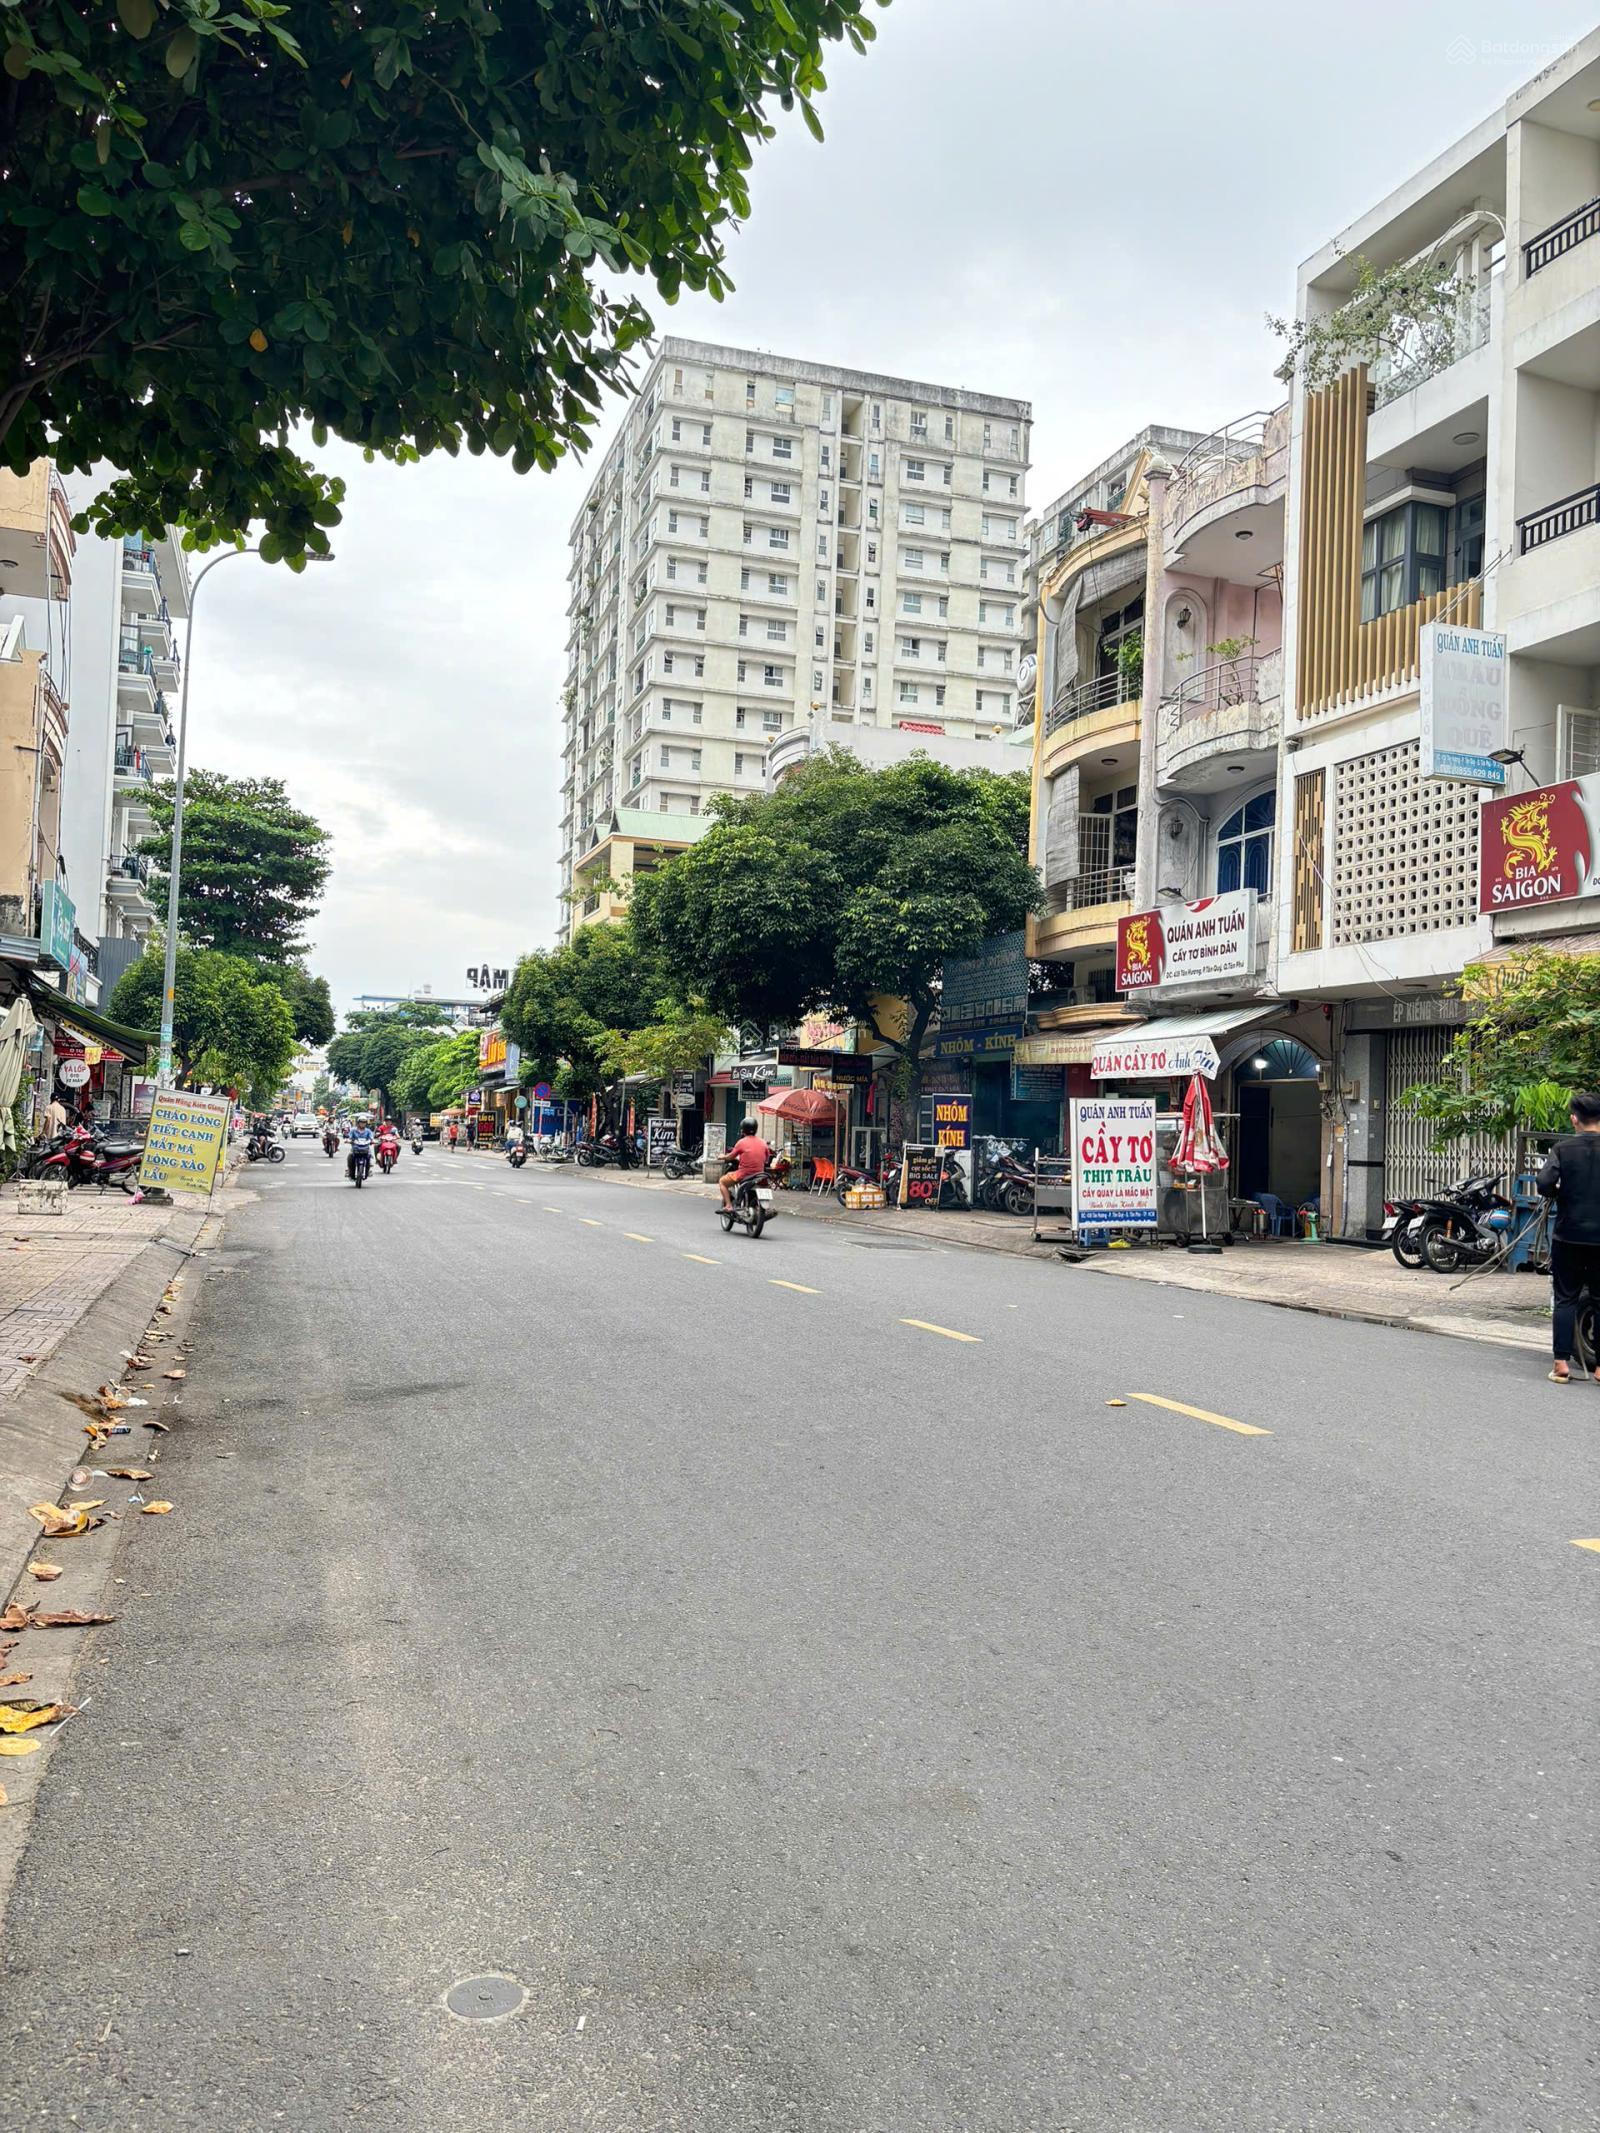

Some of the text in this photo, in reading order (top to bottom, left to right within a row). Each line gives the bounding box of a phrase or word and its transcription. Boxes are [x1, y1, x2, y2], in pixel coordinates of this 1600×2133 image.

[1437, 632, 1503, 658] QUÁN ANH TUẤN
[1515, 865, 1537, 880] BIA
[1492, 873, 1561, 904] SAIGON
[1167, 908, 1245, 943] QUÁN ANH TUẤN
[1201, 944, 1219, 958] BÌNH
[1220, 940, 1237, 955] DÂN
[1121, 969, 1152, 986] SAIGON
[941, 1037, 974, 1054] NHÔM
[1092, 1050, 1121, 1076] QUÁN
[1151, 1049, 1166, 1070] TƠ
[156, 1109, 187, 1121] CHÁO
[936, 1100, 968, 1121] NHÔM
[1080, 1101, 1152, 1122] QUÁN ANH TUẤN
[152, 1123, 214, 1142] TIẾT CANH
[652, 1128, 675, 1140] Kim
[938, 1125, 966, 1147] KÍNH
[1082, 1121, 1153, 1163] CẦY TƠ
[146, 1153, 177, 1167] LÒNG
[1083, 1165, 1152, 1186] THỊT TRÂU
[1097, 1189, 1114, 1198] QUAY
